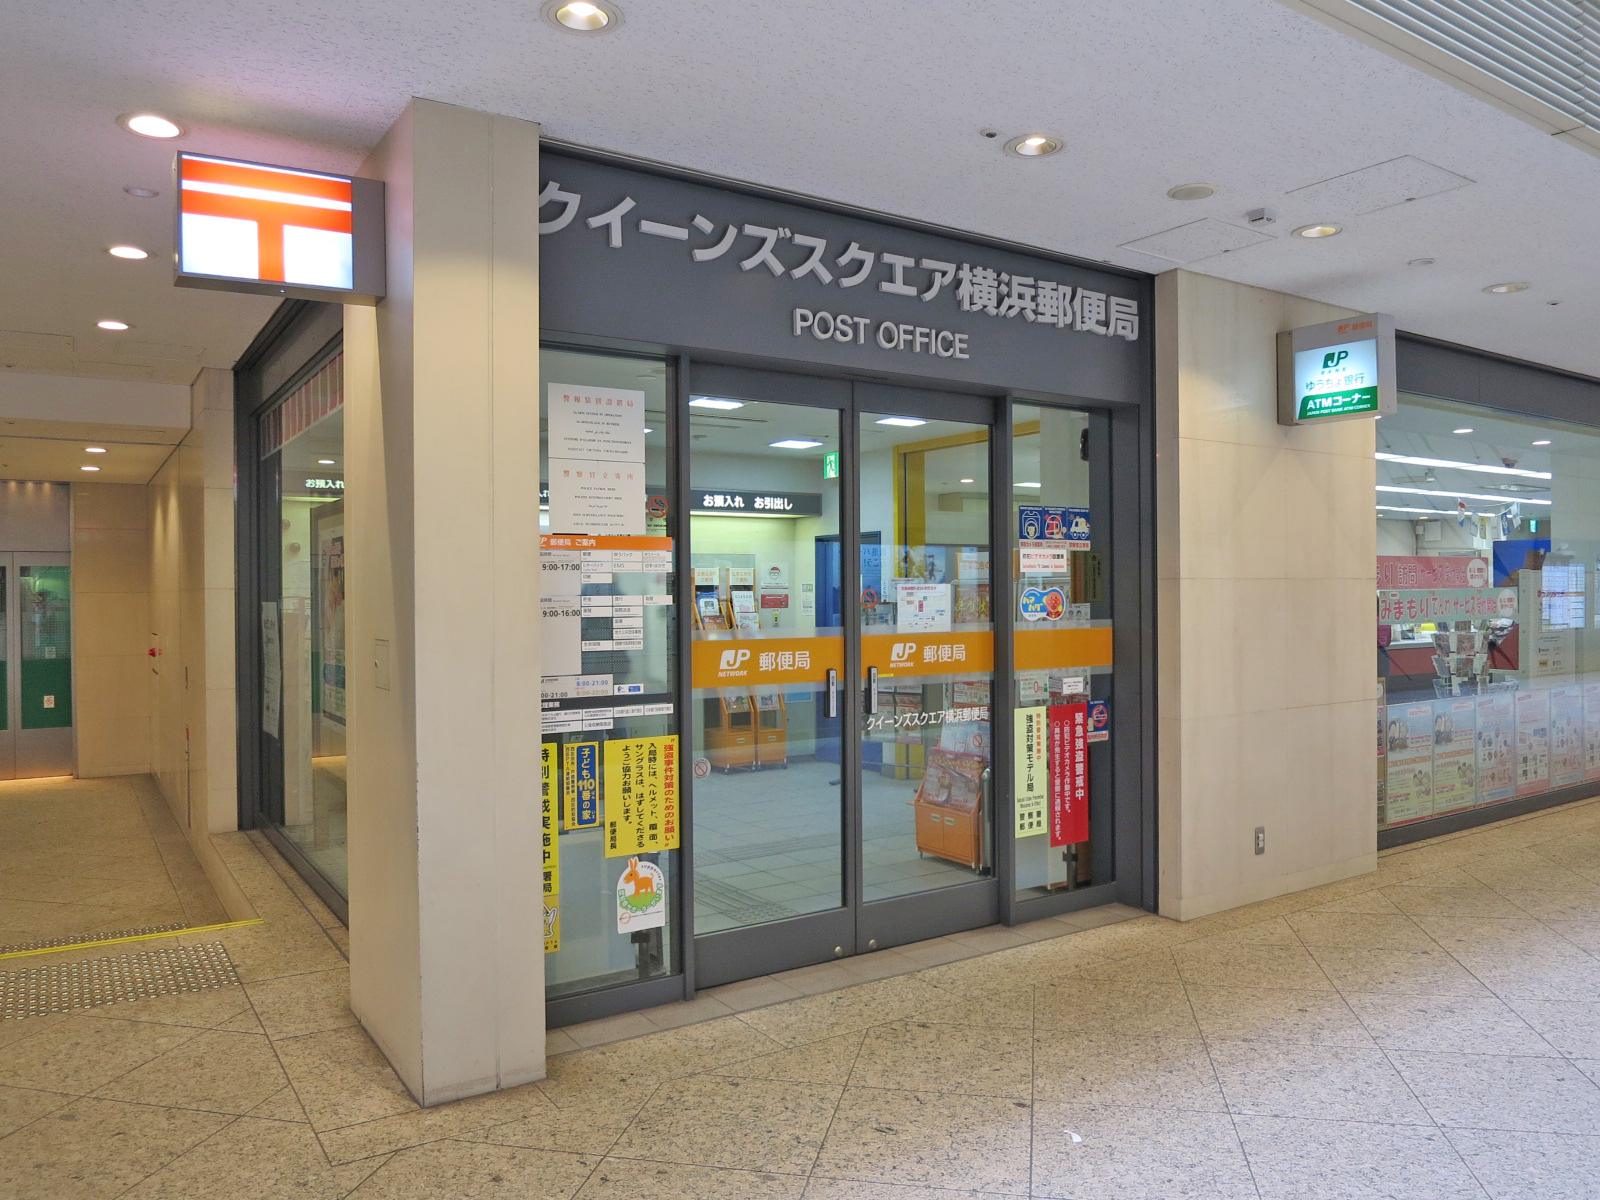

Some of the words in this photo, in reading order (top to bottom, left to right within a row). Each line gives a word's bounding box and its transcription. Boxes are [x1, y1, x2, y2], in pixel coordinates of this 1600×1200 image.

[539, 181, 1139, 341] クイーンズスクエア横浜郵便局
[793, 307, 871, 345] POST
[878, 319, 970, 360] OFFICE
[1305, 373, 1366, 392] ゆうちょ銀行
[1306, 393, 1371, 410] ATMコーナー
[754, 496, 793, 510] お引出し
[550, 538, 571, 546] 郵便局
[575, 538, 596, 546] ご案内
[542, 563, 580, 571] 9:00-17:00
[542, 609, 581, 617] 9:00-16:00
[759, 651, 811, 672] 郵便局
[923, 644, 966, 663] 郵便局
[866, 706, 988, 731] クイーンズスクエア横浜郵便局
[1026, 714, 1034, 793] 強盗対策モデル局
[1075, 712, 1085, 801] 緊急強盗警戒中
